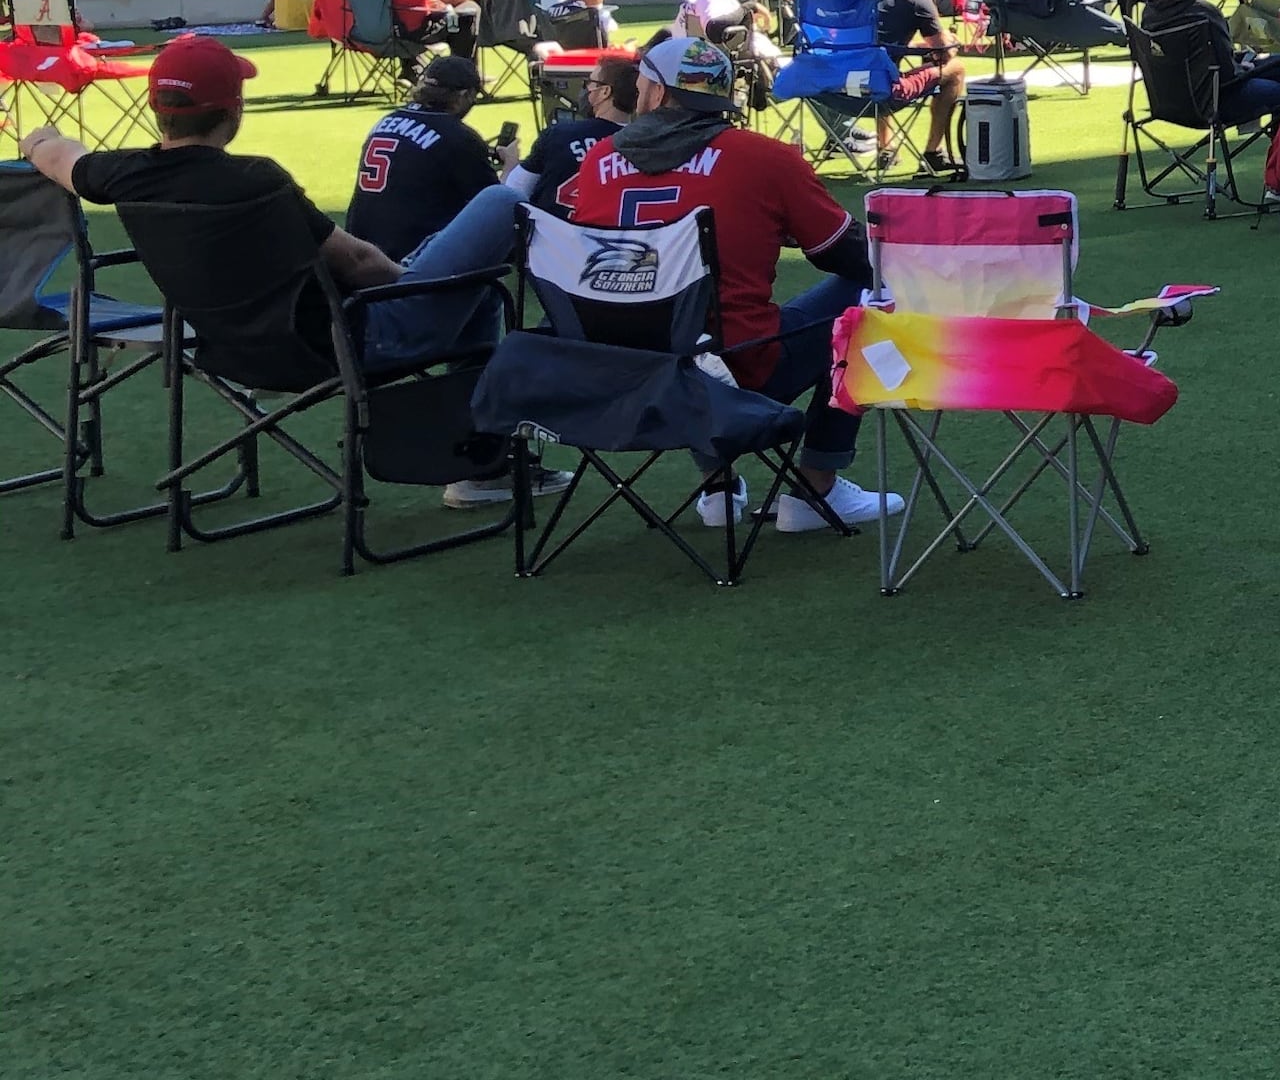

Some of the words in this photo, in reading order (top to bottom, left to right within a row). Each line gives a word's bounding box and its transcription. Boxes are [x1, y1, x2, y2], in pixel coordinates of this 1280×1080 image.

[369, 116, 441, 150] EEMAN
[359, 136, 400, 193] 5
[592, 280, 653, 292] SOUTHERN
[598, 271, 656, 282] GEORGIA
